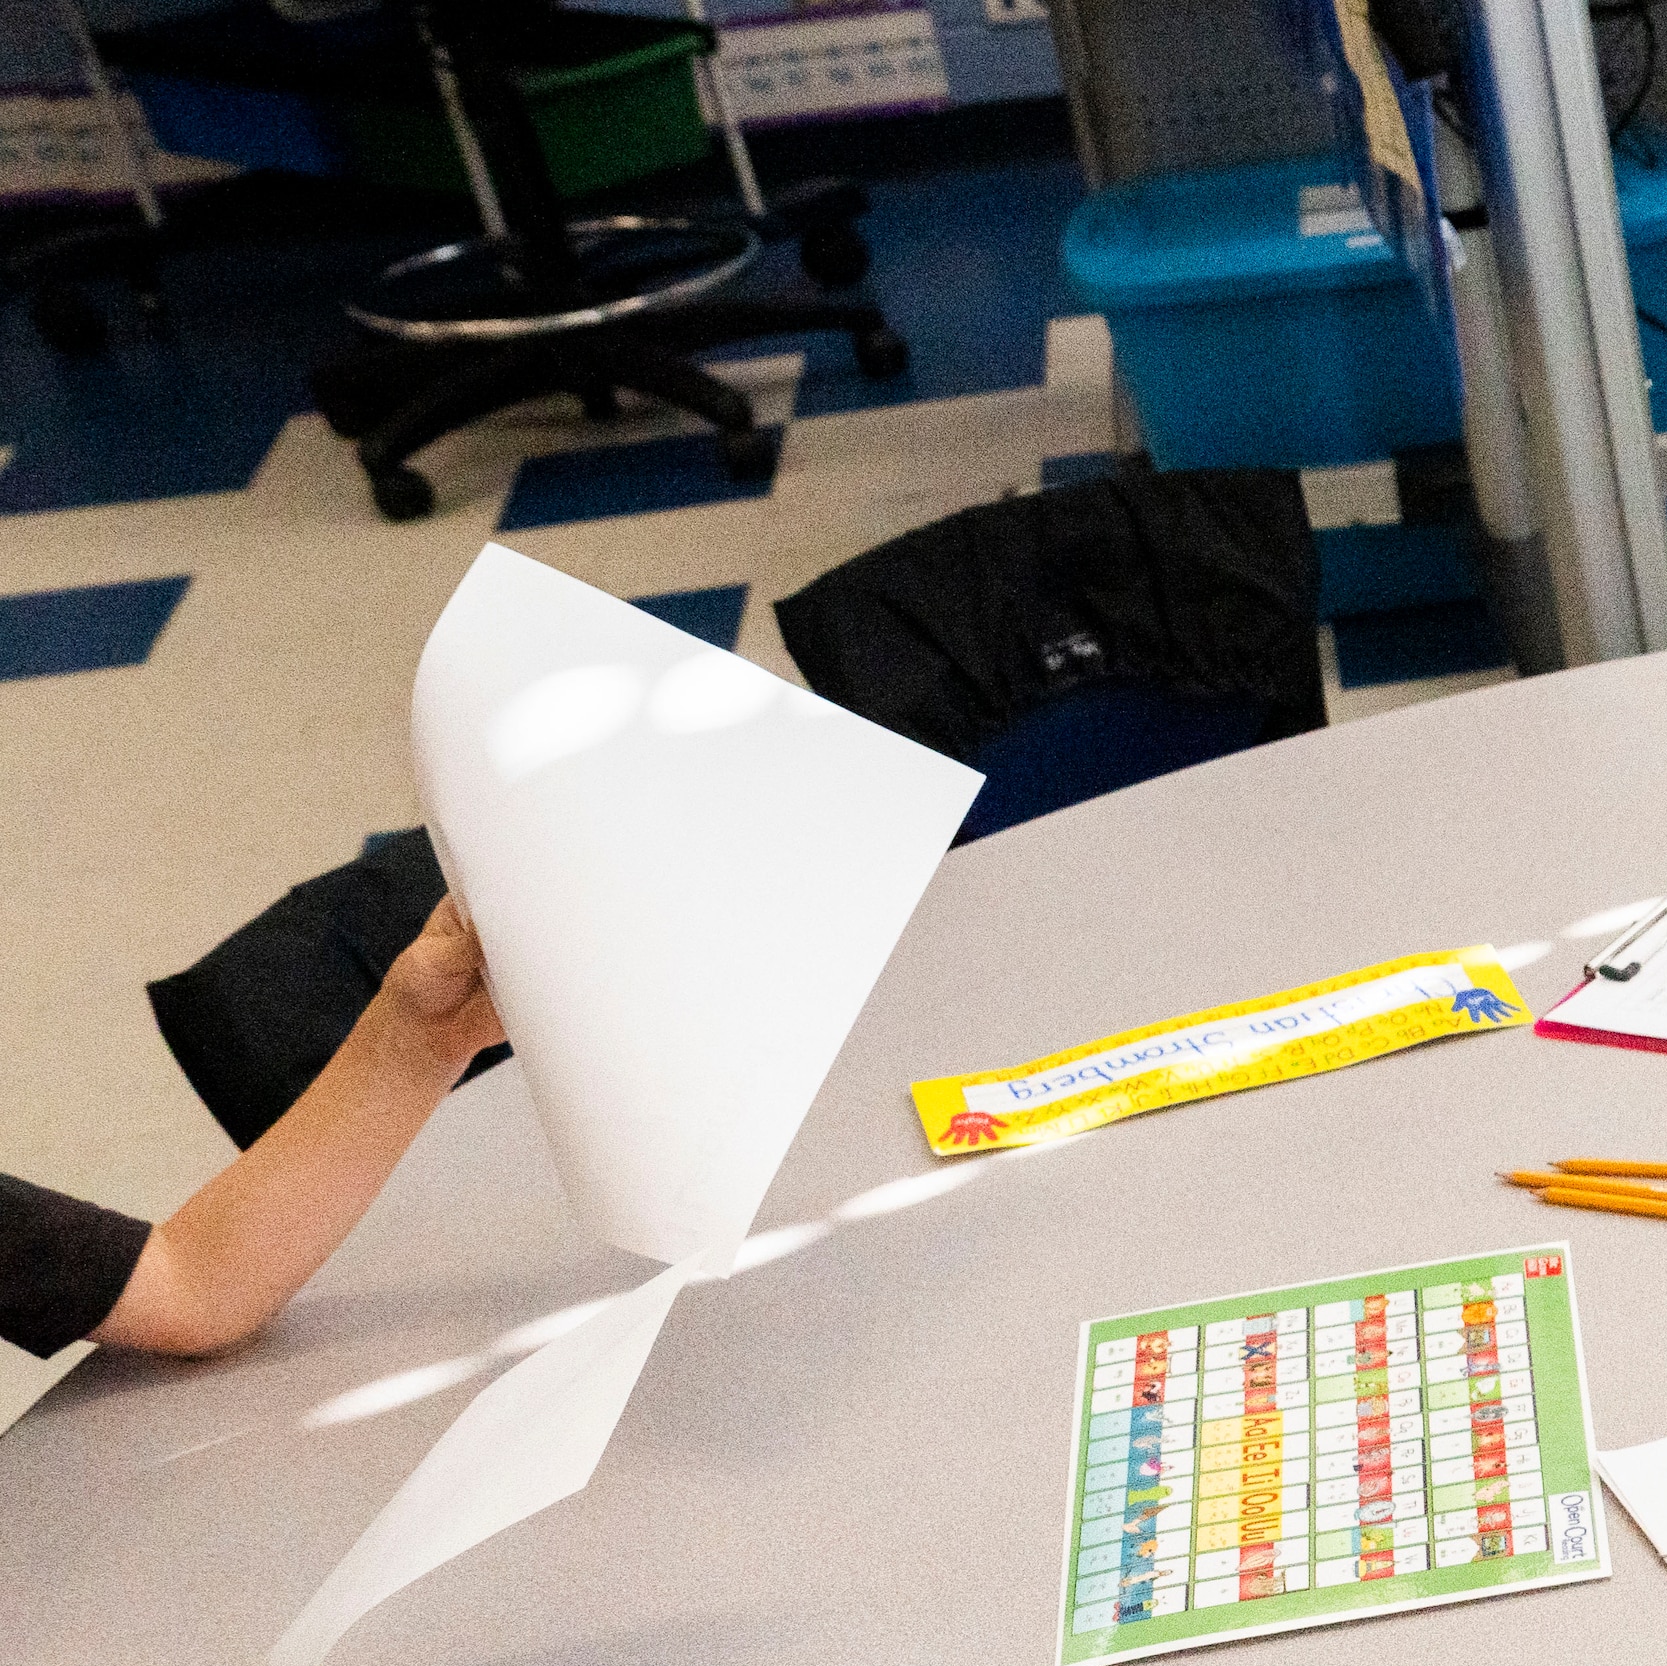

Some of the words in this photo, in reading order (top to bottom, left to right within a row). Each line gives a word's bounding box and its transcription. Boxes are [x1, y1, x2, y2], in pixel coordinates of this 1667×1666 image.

[1007, 1030, 1234, 1101] Stromberg
[1244, 1417, 1280, 1436] Aa
[1242, 1441, 1279, 1461] Ee
[1242, 1469, 1279, 1486] Ii
[1241, 1492, 1278, 1515] Oo
[1241, 1518, 1279, 1543] Uu
